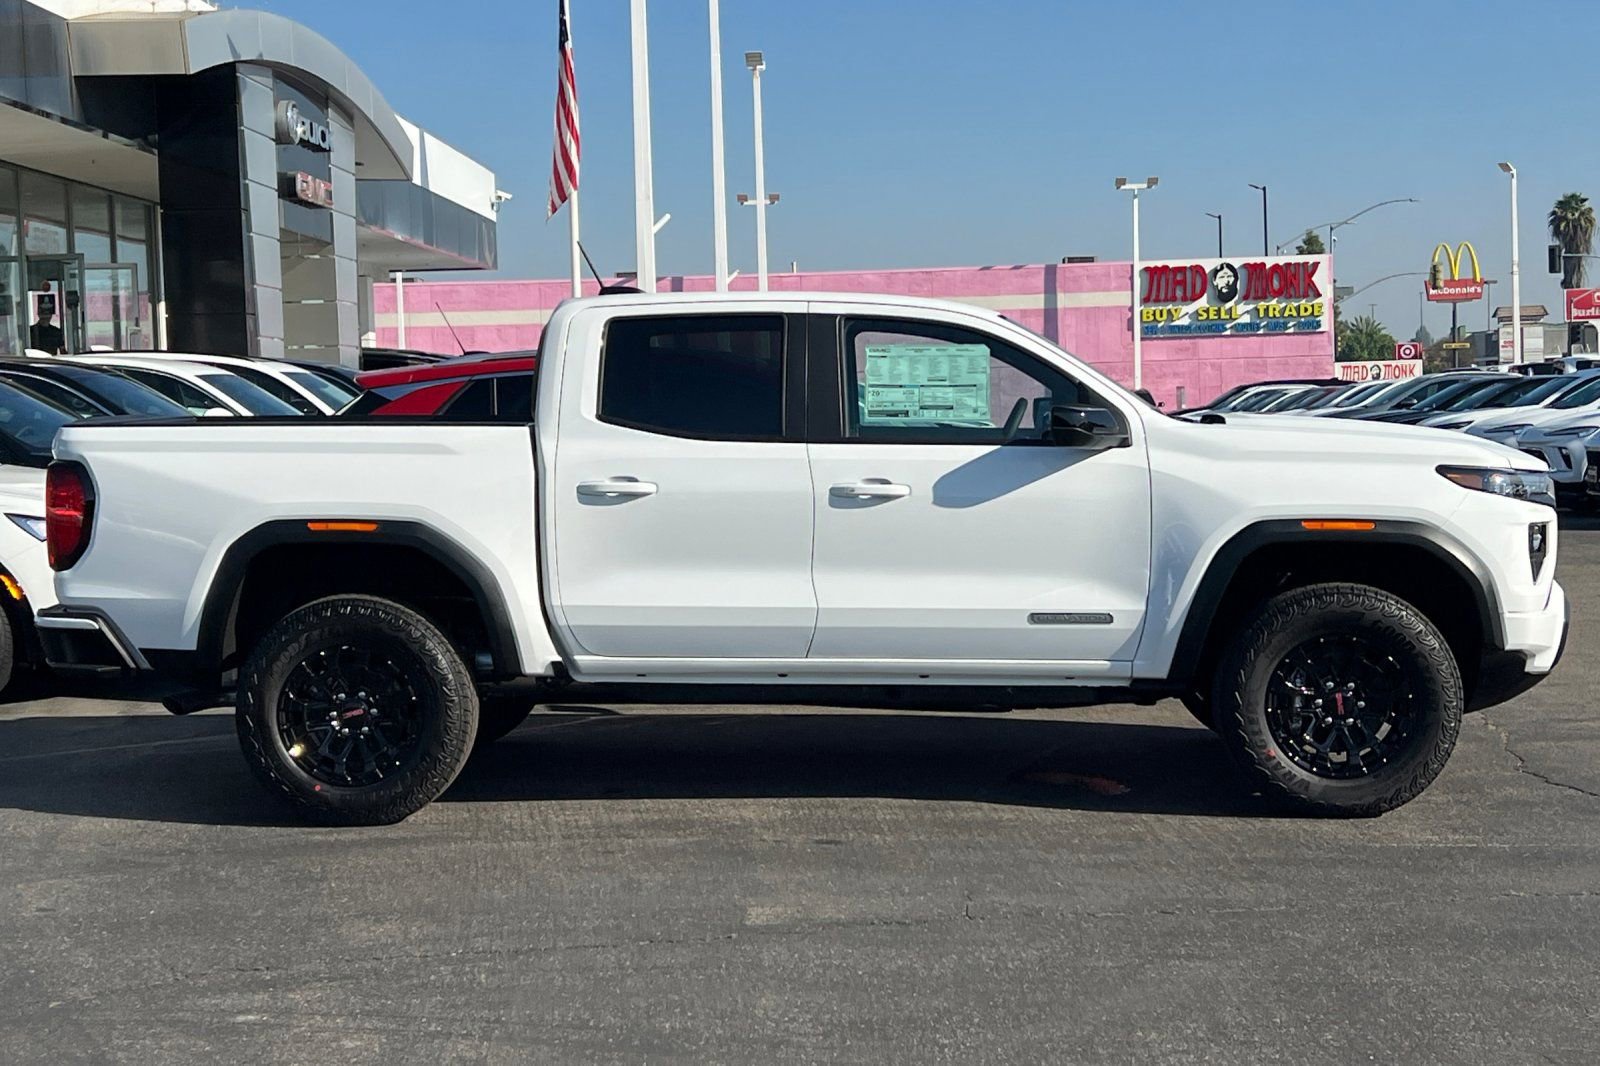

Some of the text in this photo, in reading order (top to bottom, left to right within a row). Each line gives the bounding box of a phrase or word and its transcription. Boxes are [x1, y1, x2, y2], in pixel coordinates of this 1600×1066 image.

[1142, 261, 1322, 303] MAD MONK
[1429, 286, 1482, 295] McDonald's
[1141, 302, 1324, 322] BUY SELL TRADE
[1341, 364, 1416, 380] MAD MONK
